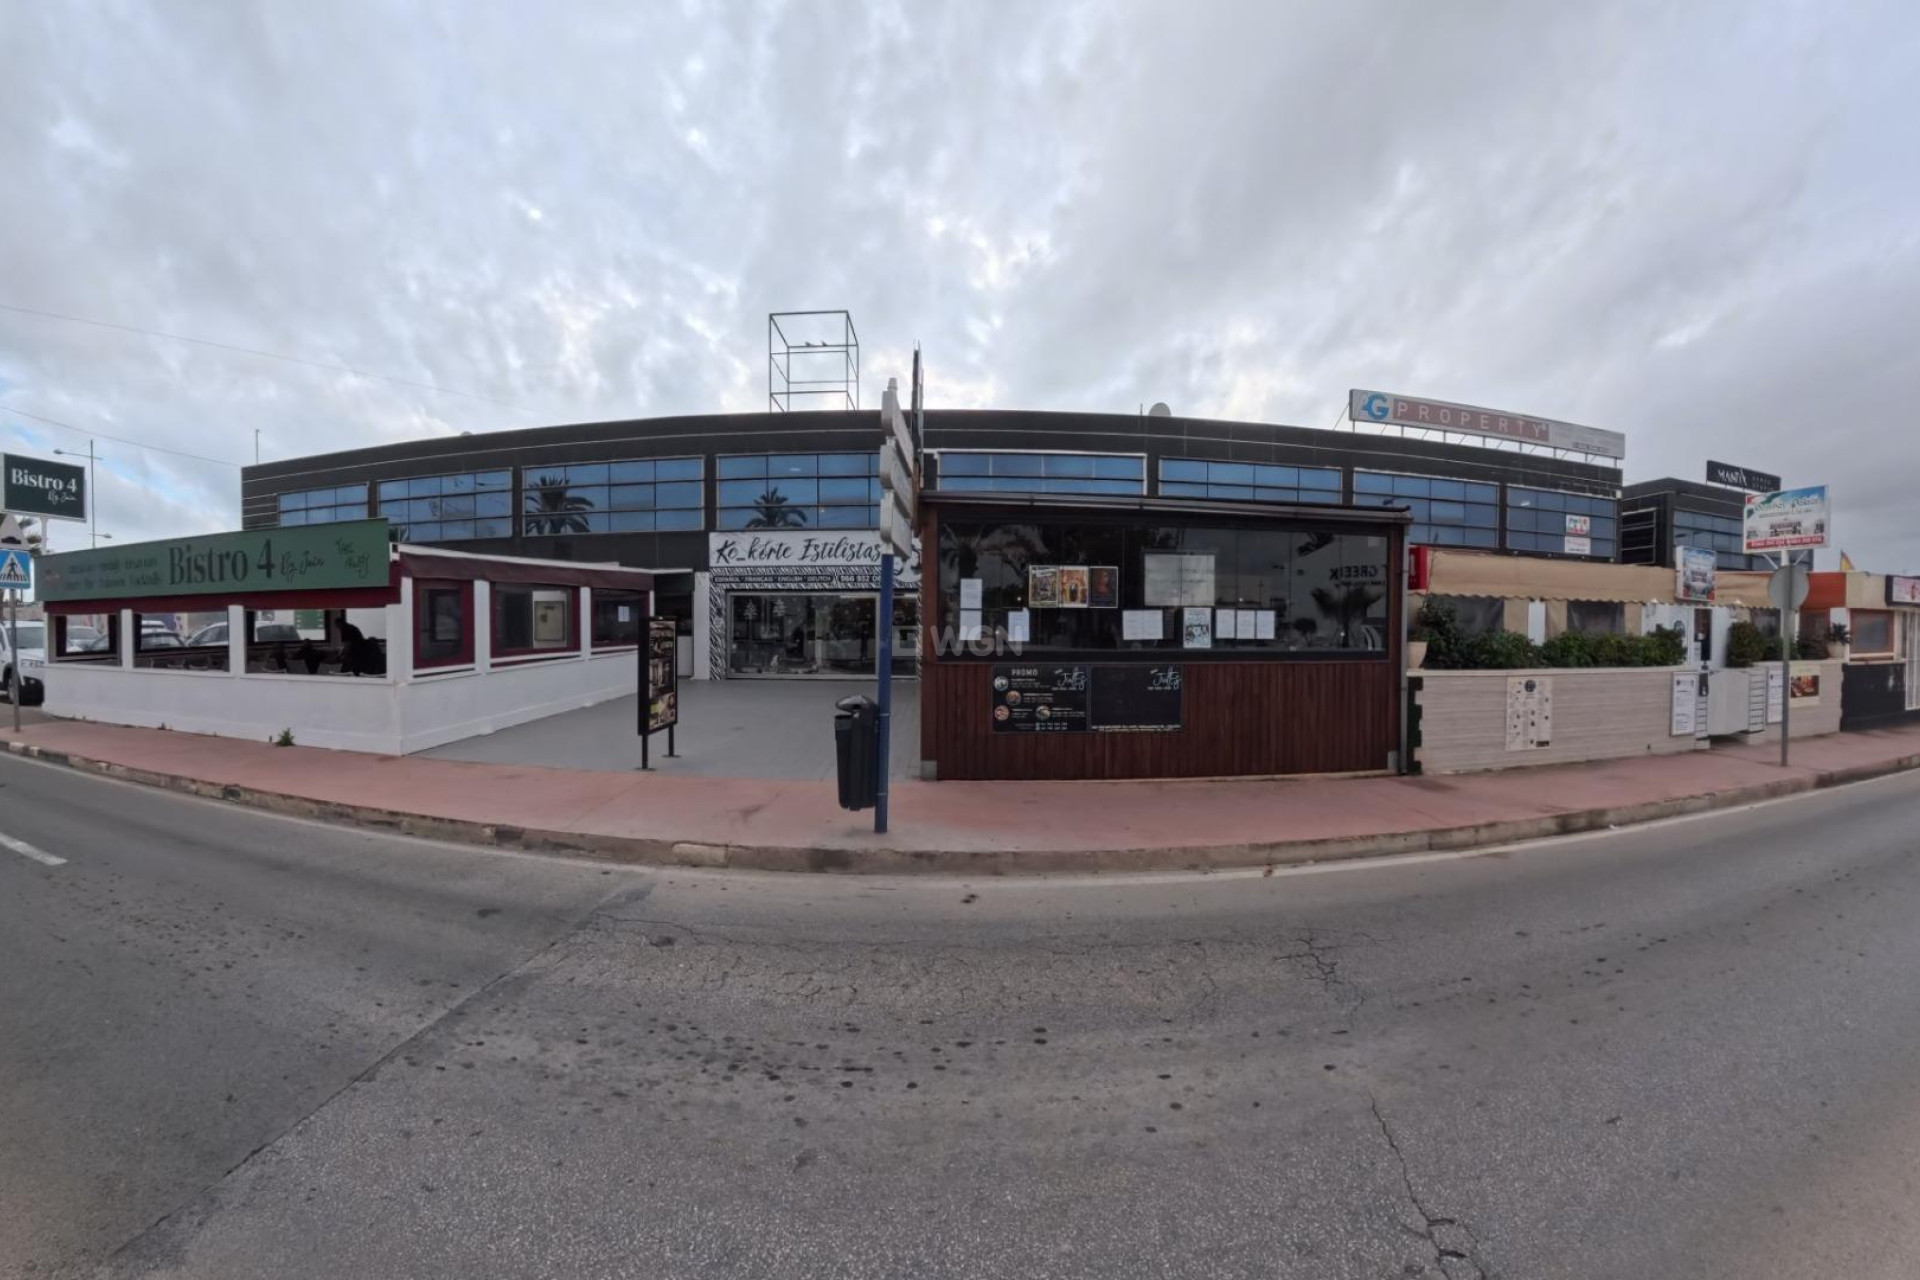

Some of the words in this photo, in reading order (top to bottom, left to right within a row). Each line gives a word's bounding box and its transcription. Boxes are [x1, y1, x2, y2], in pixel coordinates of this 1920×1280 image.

[1397, 401, 1543, 439] PROPERTY
[12, 467, 63, 491] Bistro
[66, 478, 77, 493] 4
[169, 544, 248, 586] Bistro
[256, 538, 274, 580] 4
[797, 536, 881, 562] Estilistas
[1011, 668, 1038, 677] PROMO
